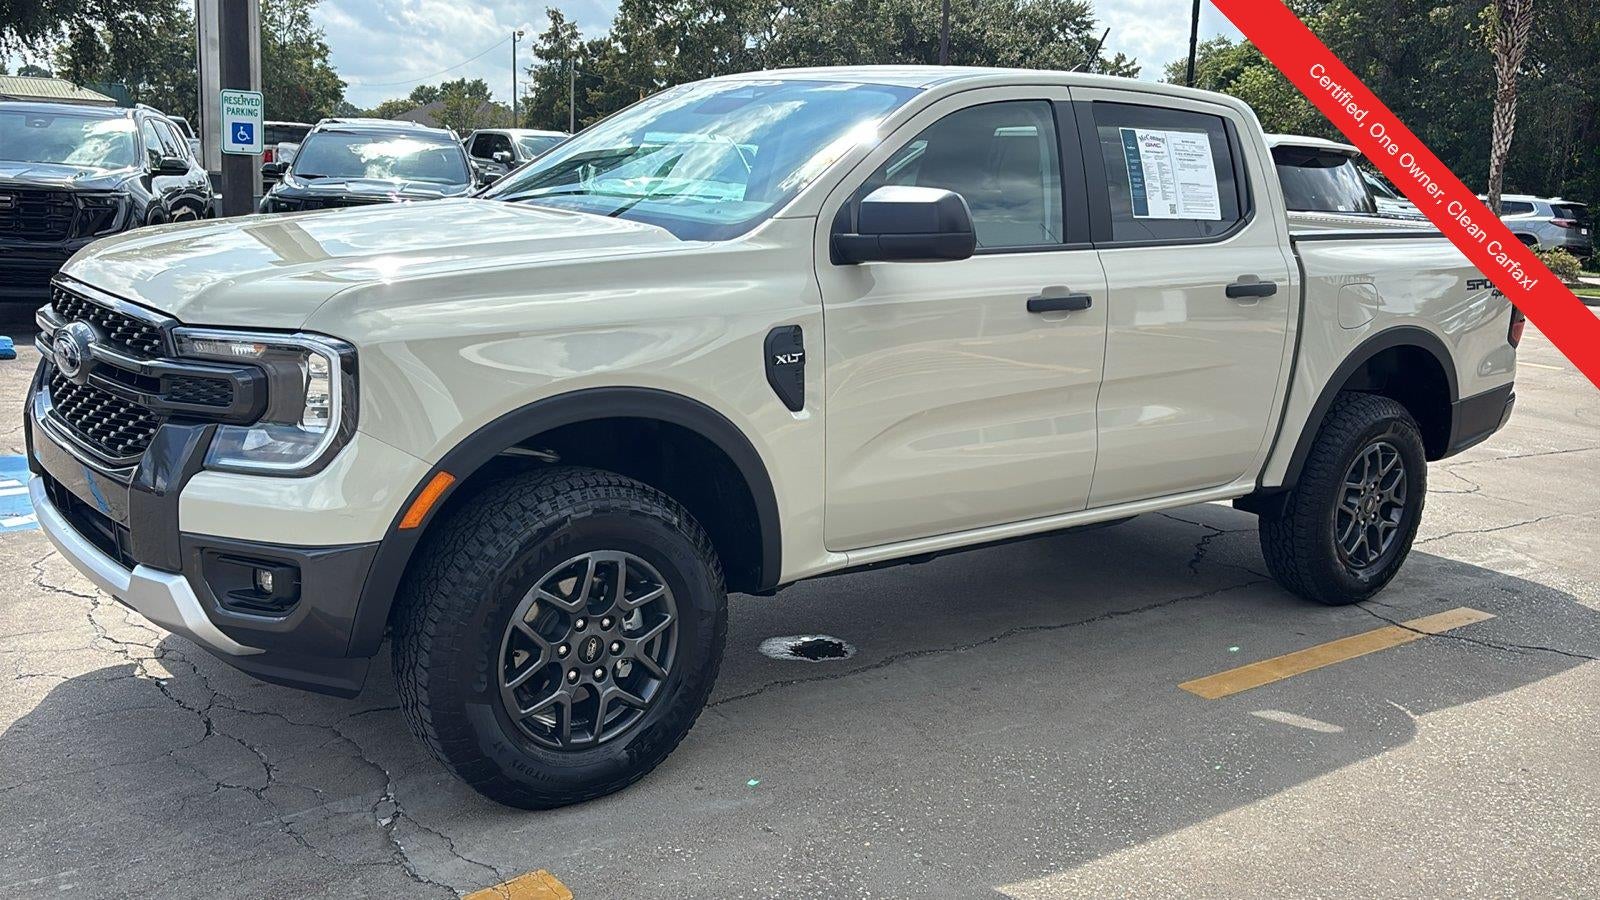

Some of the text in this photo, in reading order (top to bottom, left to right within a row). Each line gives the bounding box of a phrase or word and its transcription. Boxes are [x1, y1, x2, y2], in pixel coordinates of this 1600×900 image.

[224, 96, 260, 106] RESERVED
[226, 107, 258, 117] PARKING
[1466, 278, 1496, 291] SPO
[775, 352, 803, 365] XLT
